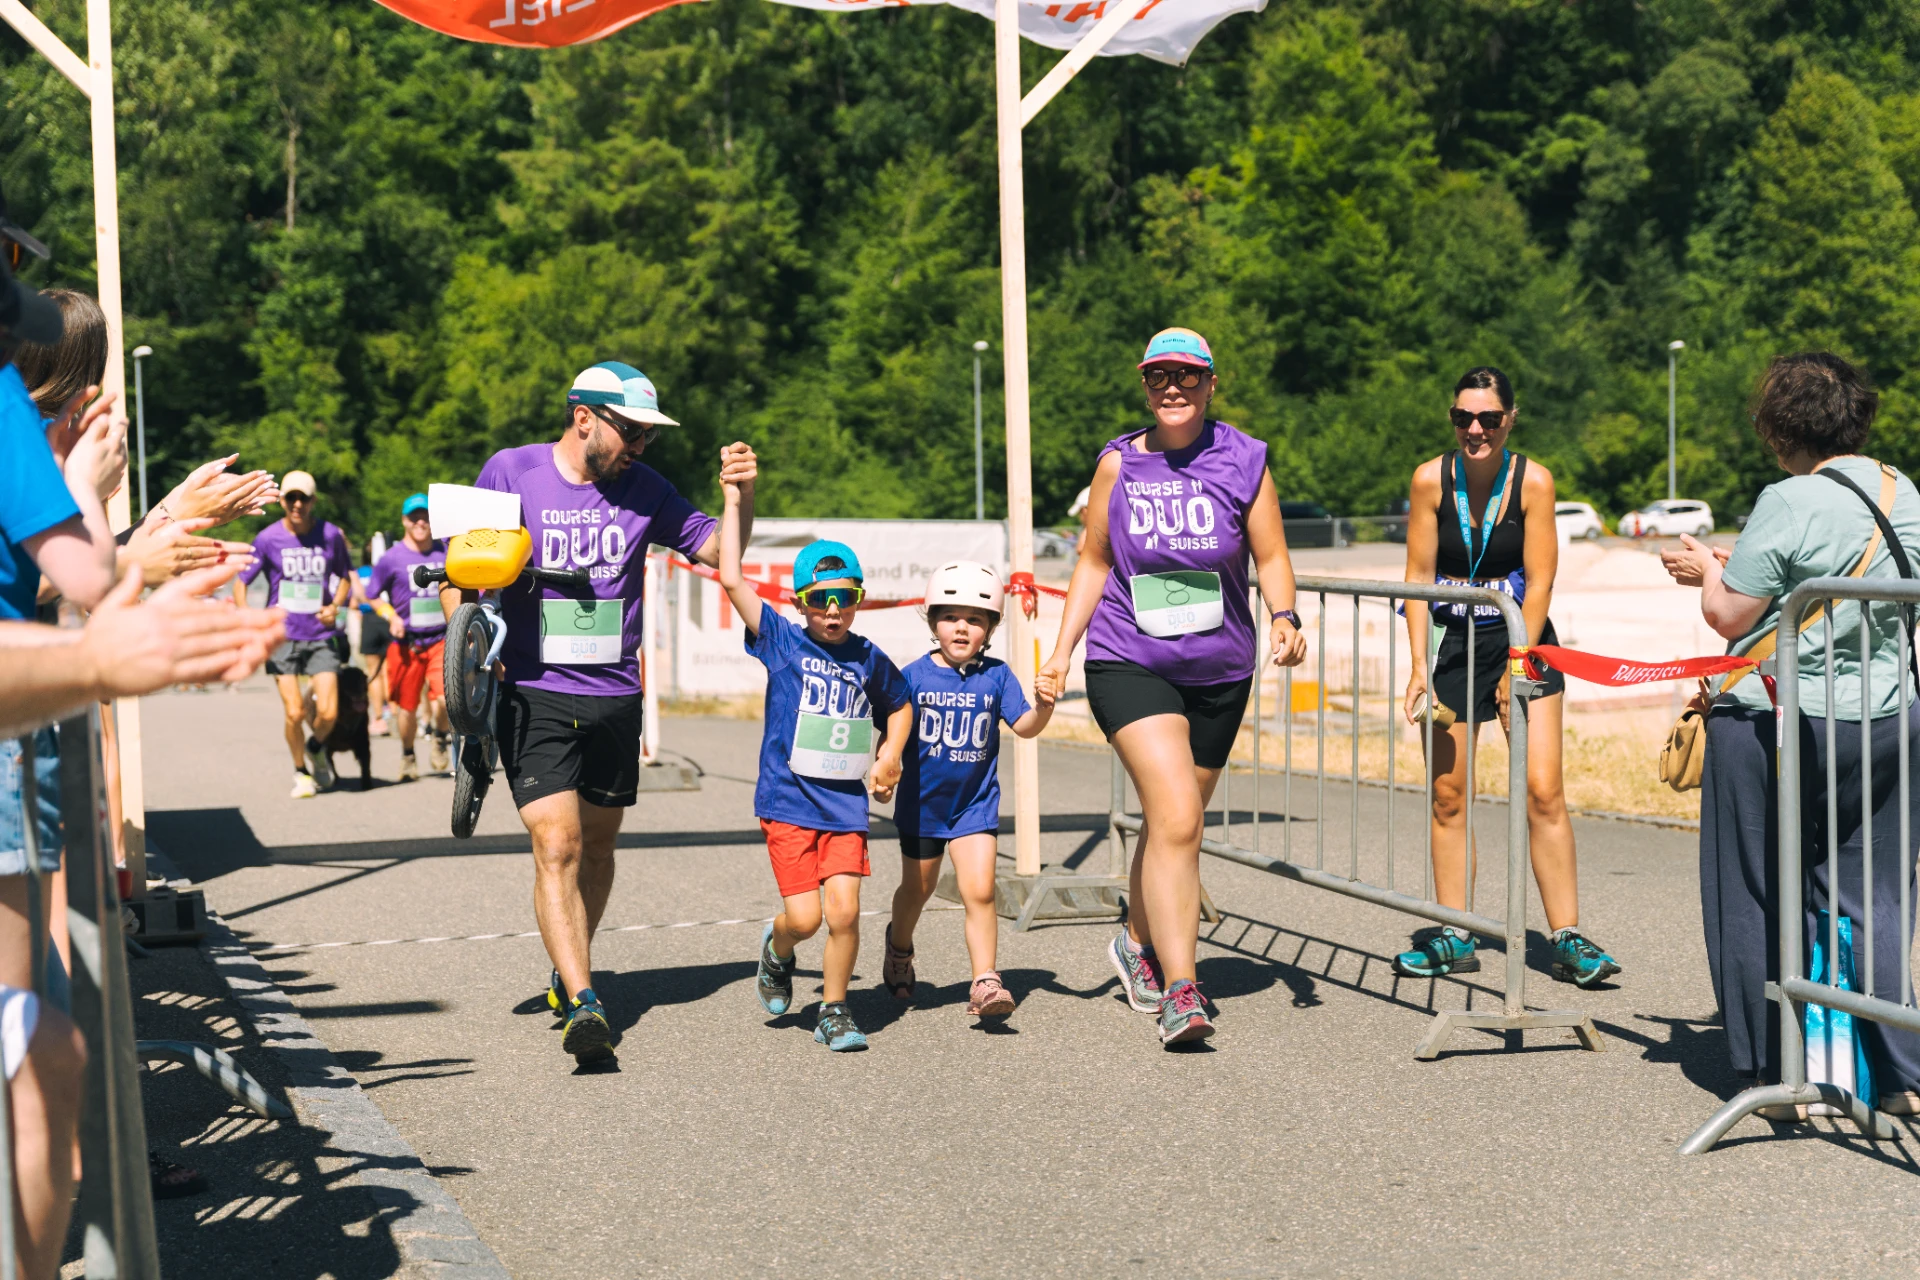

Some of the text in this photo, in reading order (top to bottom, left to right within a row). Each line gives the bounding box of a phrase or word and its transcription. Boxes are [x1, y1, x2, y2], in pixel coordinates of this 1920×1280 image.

[1125, 480, 1184, 496] COURSE
[541, 508, 602, 525] COURSE
[1127, 496, 1215, 536] DUO
[541, 524, 627, 570] DUO
[1168, 536, 1219, 550] SUISSE
[282, 555, 326, 578] DUO
[589, 565, 625, 579] UISS
[1163, 575, 1191, 606] 8
[573, 605, 598, 630] 8
[1474, 604, 1502, 617] SUIS
[570, 642, 597, 654] DUO
[917, 691, 977, 708] COURSE
[918, 706, 992, 749] DUO
[828, 722, 851, 751] 8
[948, 748, 988, 763] SUISSE
